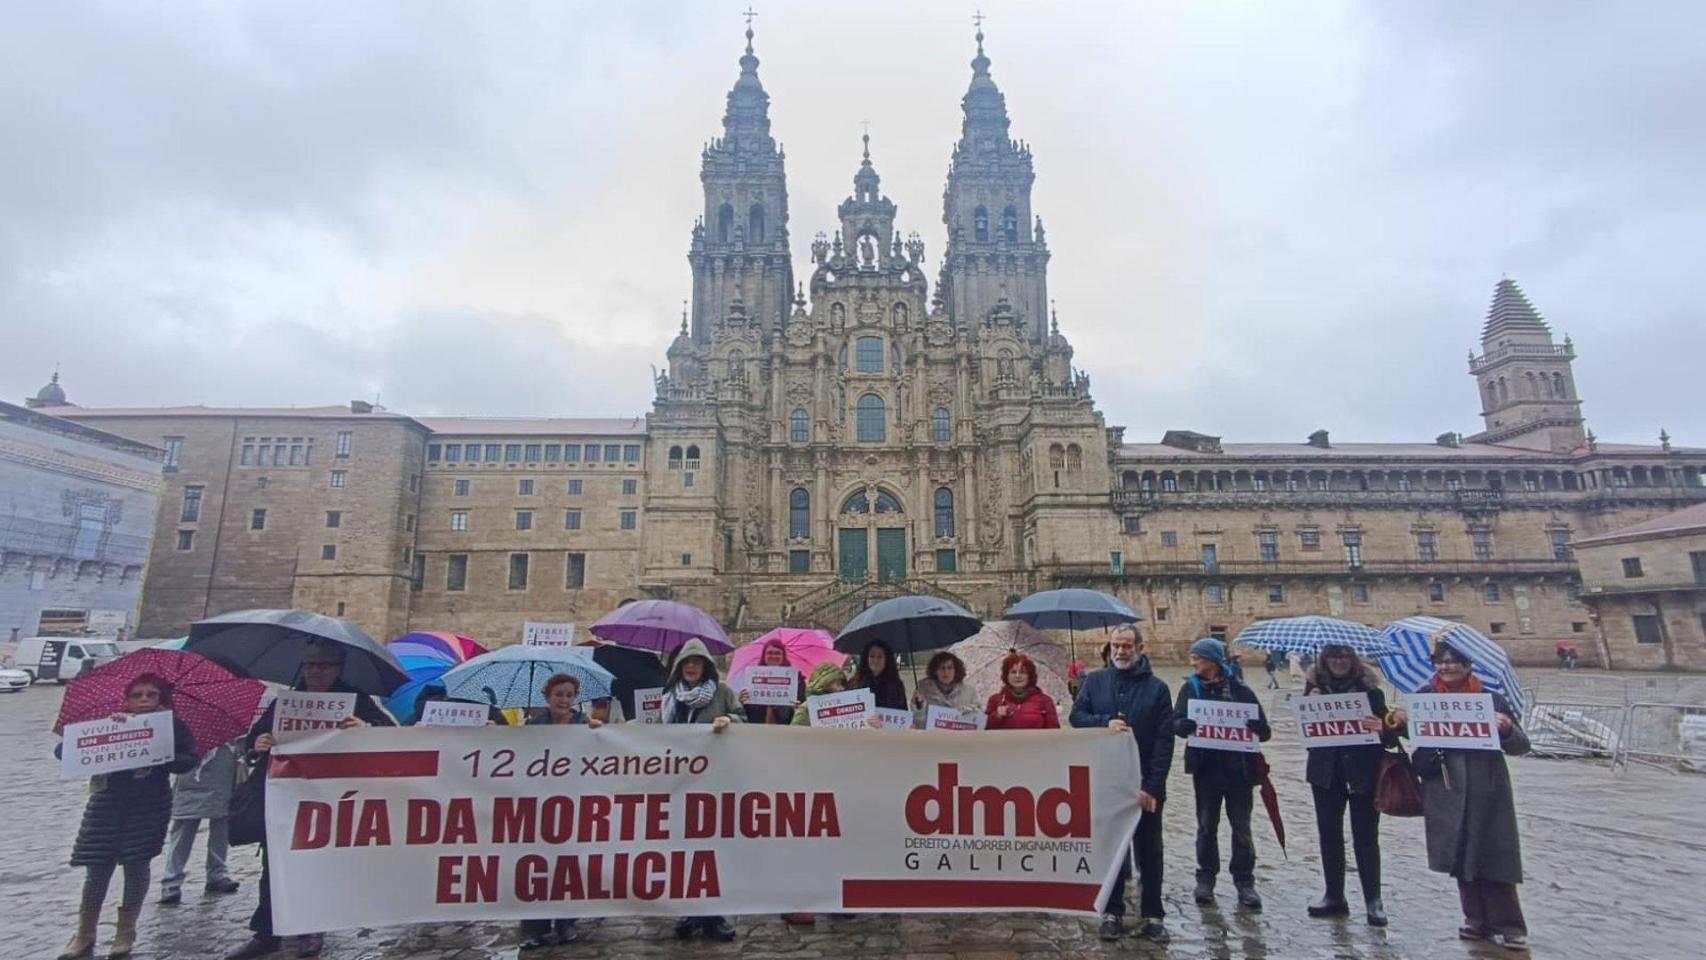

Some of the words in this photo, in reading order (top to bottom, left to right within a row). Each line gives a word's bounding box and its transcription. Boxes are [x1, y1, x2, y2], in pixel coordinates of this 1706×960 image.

[752, 690, 790, 698] OBRIGA
[281, 698, 346, 711] #LIBRES
[819, 710, 830, 718] UN
[836, 704, 863, 715] DEREITO
[1300, 700, 1362, 712] #LIBRES
[1412, 701, 1484, 712] #LIBRES
[430, 708, 482, 719] #LIBRES
[1195, 708, 1251, 719] #LIBRES
[80, 724, 119, 736] VIVIR
[1196, 725, 1251, 742] FINAL
[1304, 720, 1370, 736] FINAL
[1416, 721, 1490, 737] FINAL
[80, 738, 98, 747] UN
[108, 731, 151, 743] DEREITO
[80, 746, 110, 756] NON
[114, 740, 152, 751] UNHA
[80, 748, 150, 766] OBRIGA
[462, 749, 516, 778] 12
[526, 749, 571, 777] de
[580, 750, 709, 776] xaneiro
[904, 762, 1092, 838] dmd
[290, 790, 392, 851] DÍA
[405, 798, 478, 846] DA
[492, 793, 671, 845] MORTE
[684, 791, 841, 840] DIGNA
[904, 838, 950, 850] DEREITO
[952, 840, 962, 850] A
[963, 840, 1012, 851] MORRER
[1014, 840, 1092, 854] DIGNAMENTE
[904, 852, 1092, 874] GALICIA
[436, 856, 500, 904] EN
[514, 850, 720, 902] GALICIA
